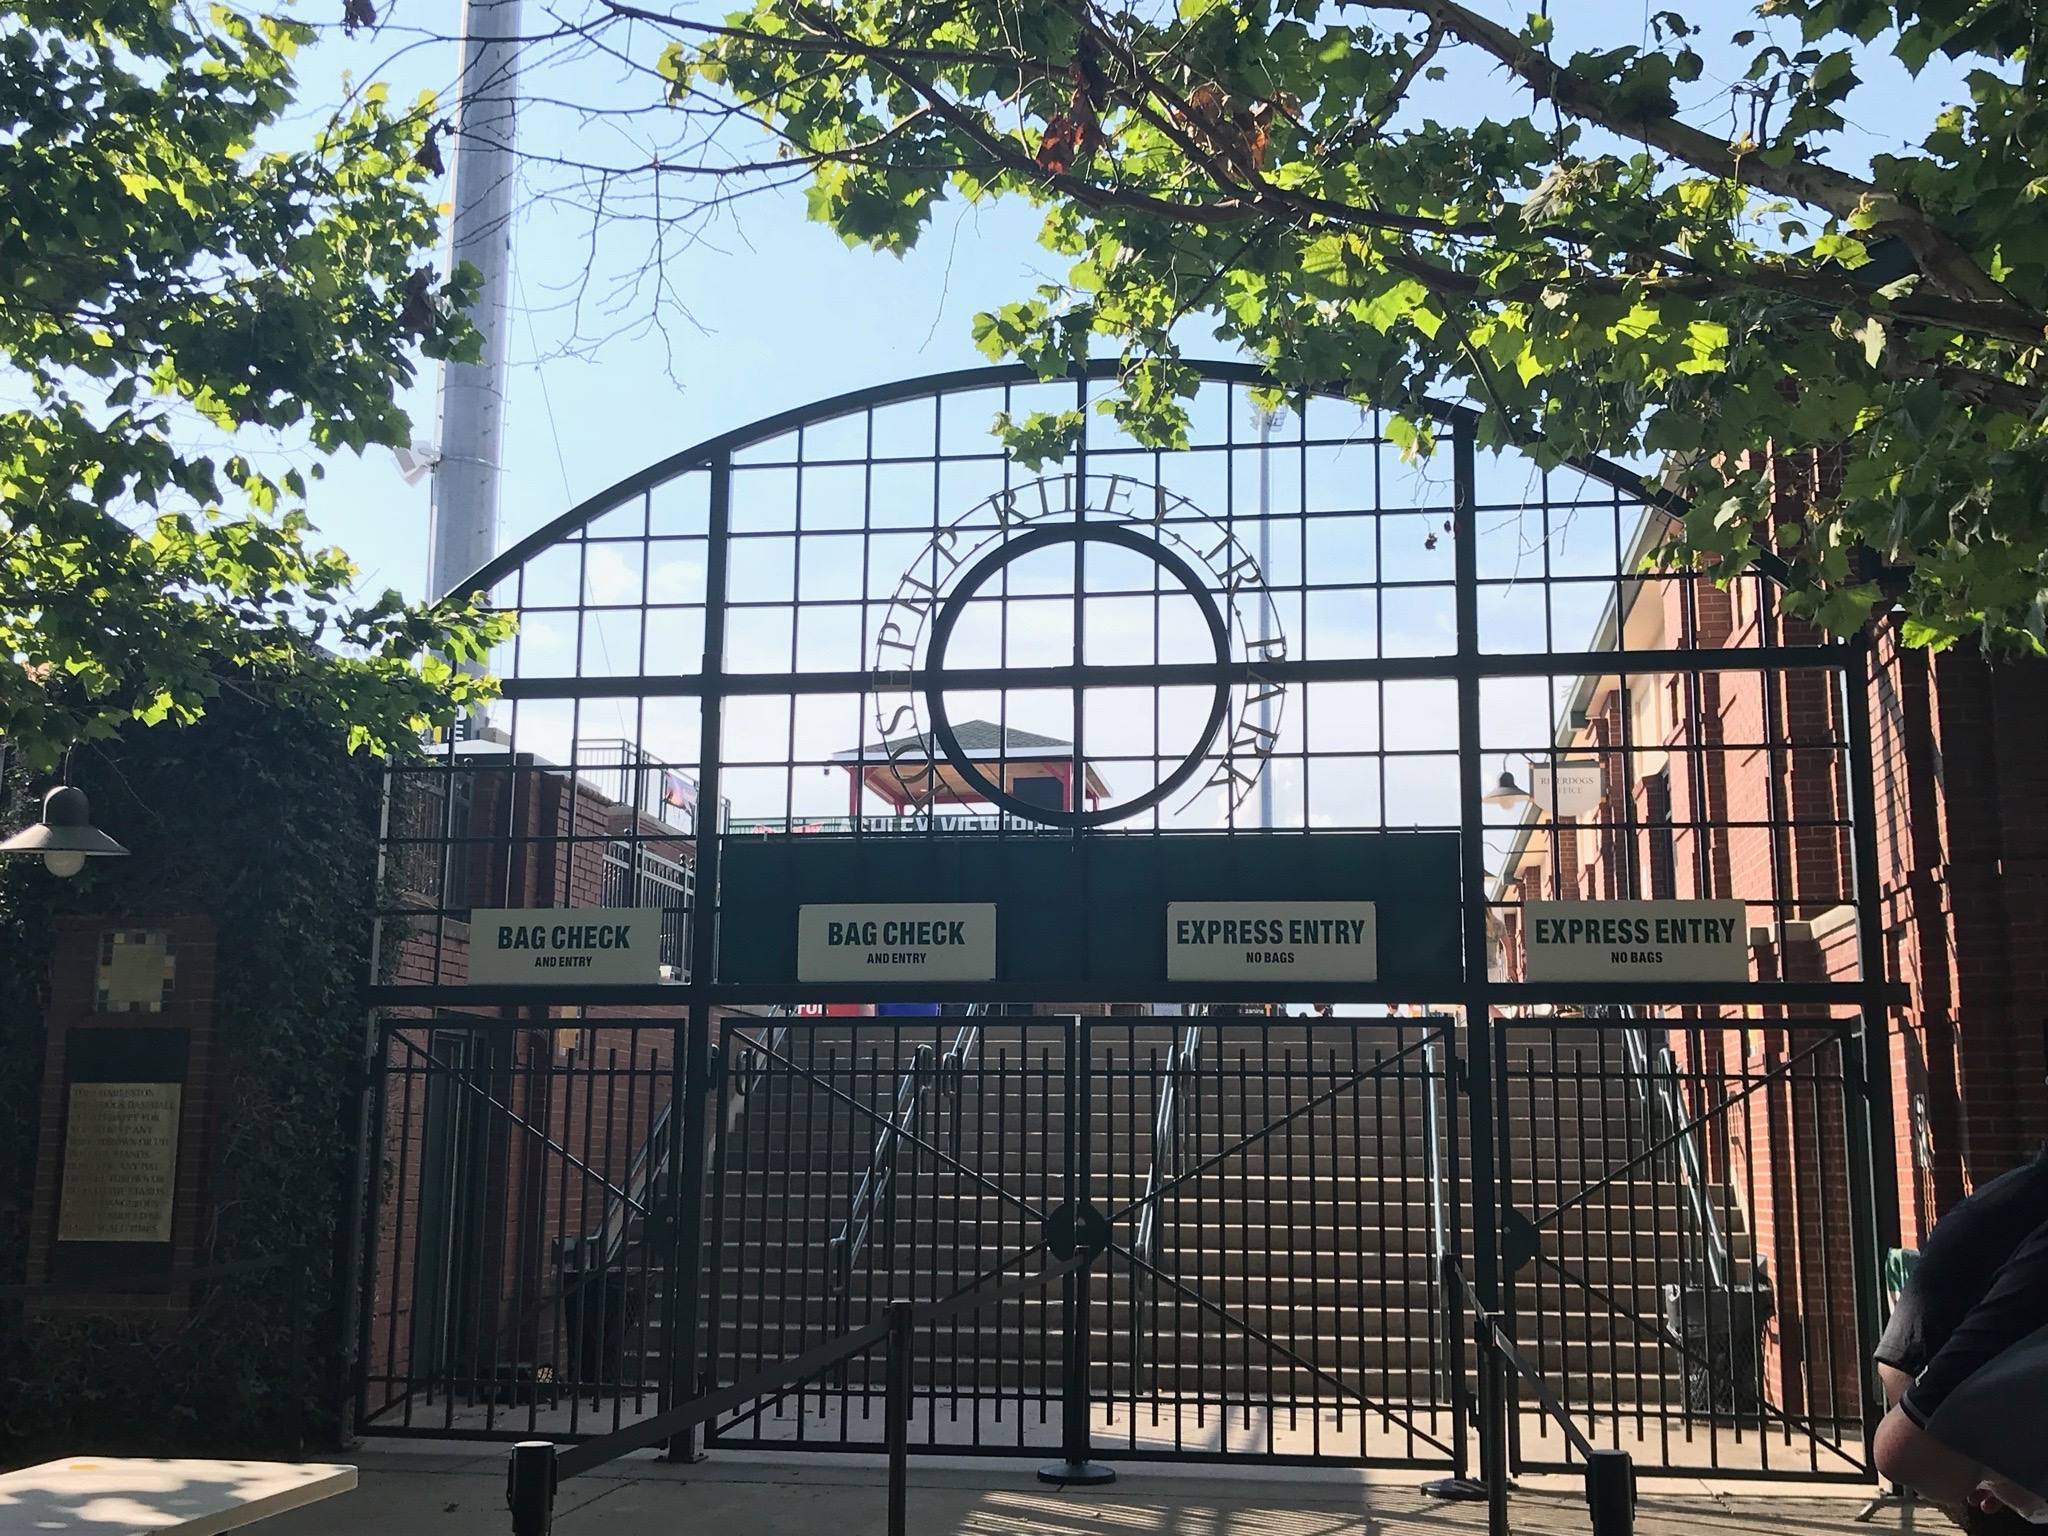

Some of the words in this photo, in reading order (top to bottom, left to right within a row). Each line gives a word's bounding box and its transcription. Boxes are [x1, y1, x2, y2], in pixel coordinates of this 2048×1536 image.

[1206, 635, 1287, 818] PARK
[498, 925, 545, 949] BAG
[551, 925, 631, 949] CHECK
[828, 922, 877, 945] BAG
[883, 921, 965, 945] CHECK
[1177, 920, 1283, 944] EXPRESS
[1289, 920, 1365, 944] ENTRY
[1536, 918, 1649, 944] EXPRESS
[1655, 918, 1735, 944] ENTRY
[534, 956, 556, 967] AND
[559, 956, 592, 967] ENTRY
[867, 953, 890, 964] AND
[892, 953, 926, 964] ENTRY
[1246, 952, 1262, 963] NO
[1264, 952, 1295, 963] BAGS
[1611, 952, 1628, 963] NO
[1630, 952, 1663, 963] BAGS
